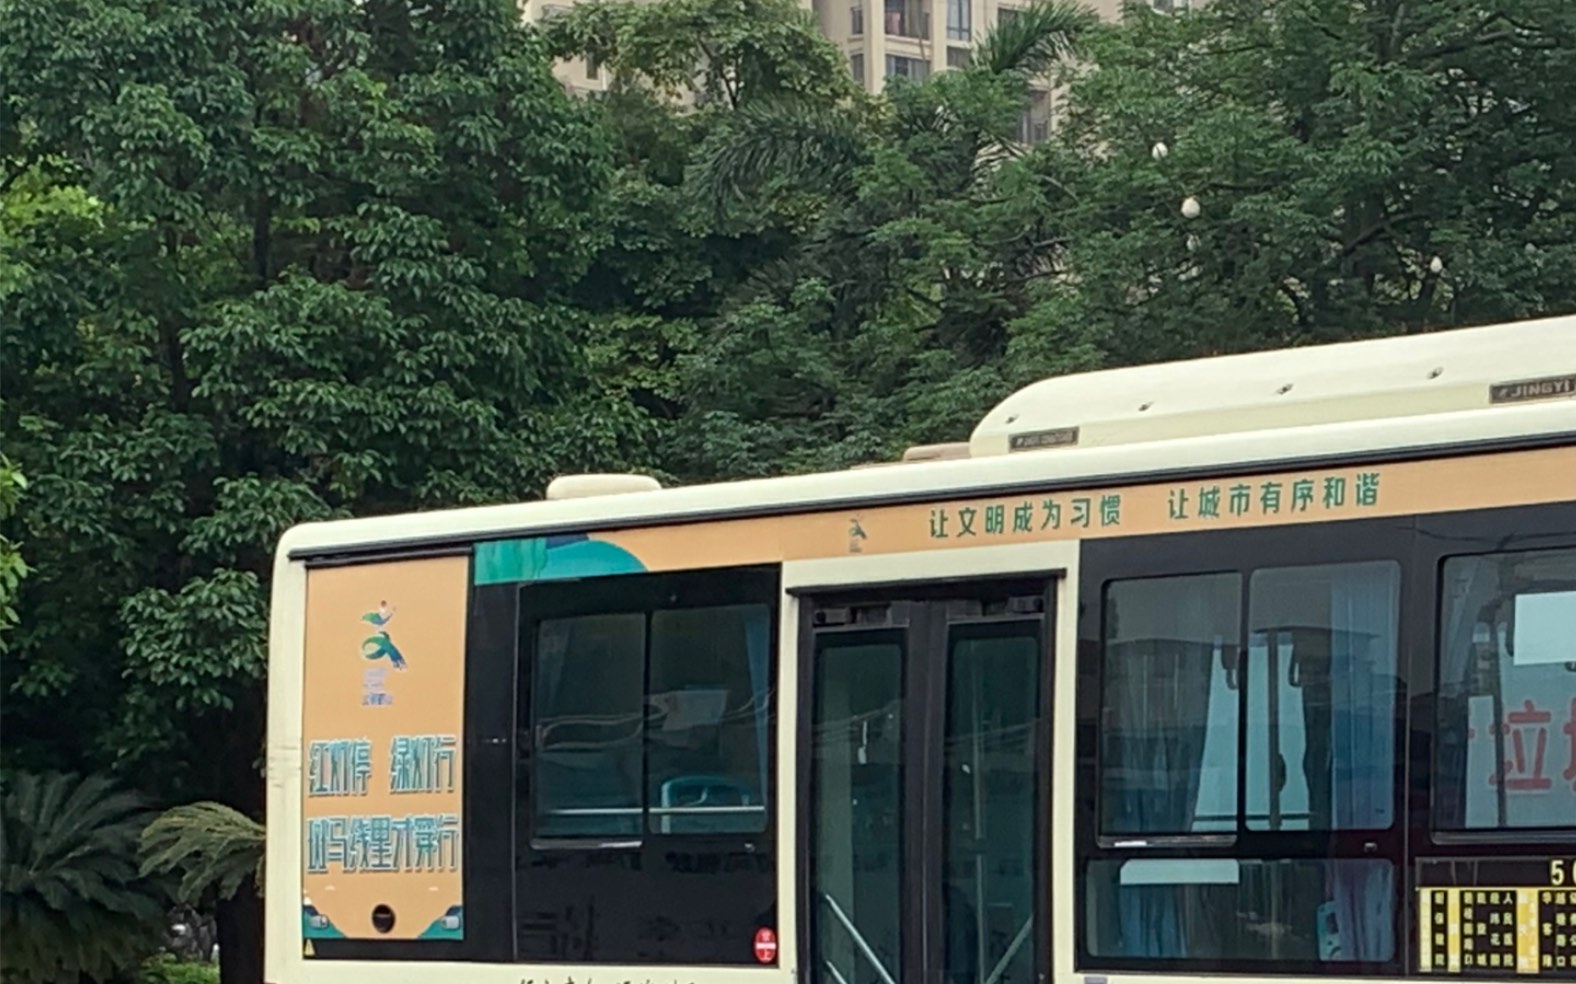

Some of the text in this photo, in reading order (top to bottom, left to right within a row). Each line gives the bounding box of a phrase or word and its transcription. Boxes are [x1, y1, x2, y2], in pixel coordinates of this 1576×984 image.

[1510, 379, 1570, 398] JINGYI
[929, 472, 1382, 539] 让文明成为习惯 让城市有序和谐
[308, 733, 457, 797] 红灯停 绿灯行
[306, 813, 459, 875] 斑马线里才穿行
